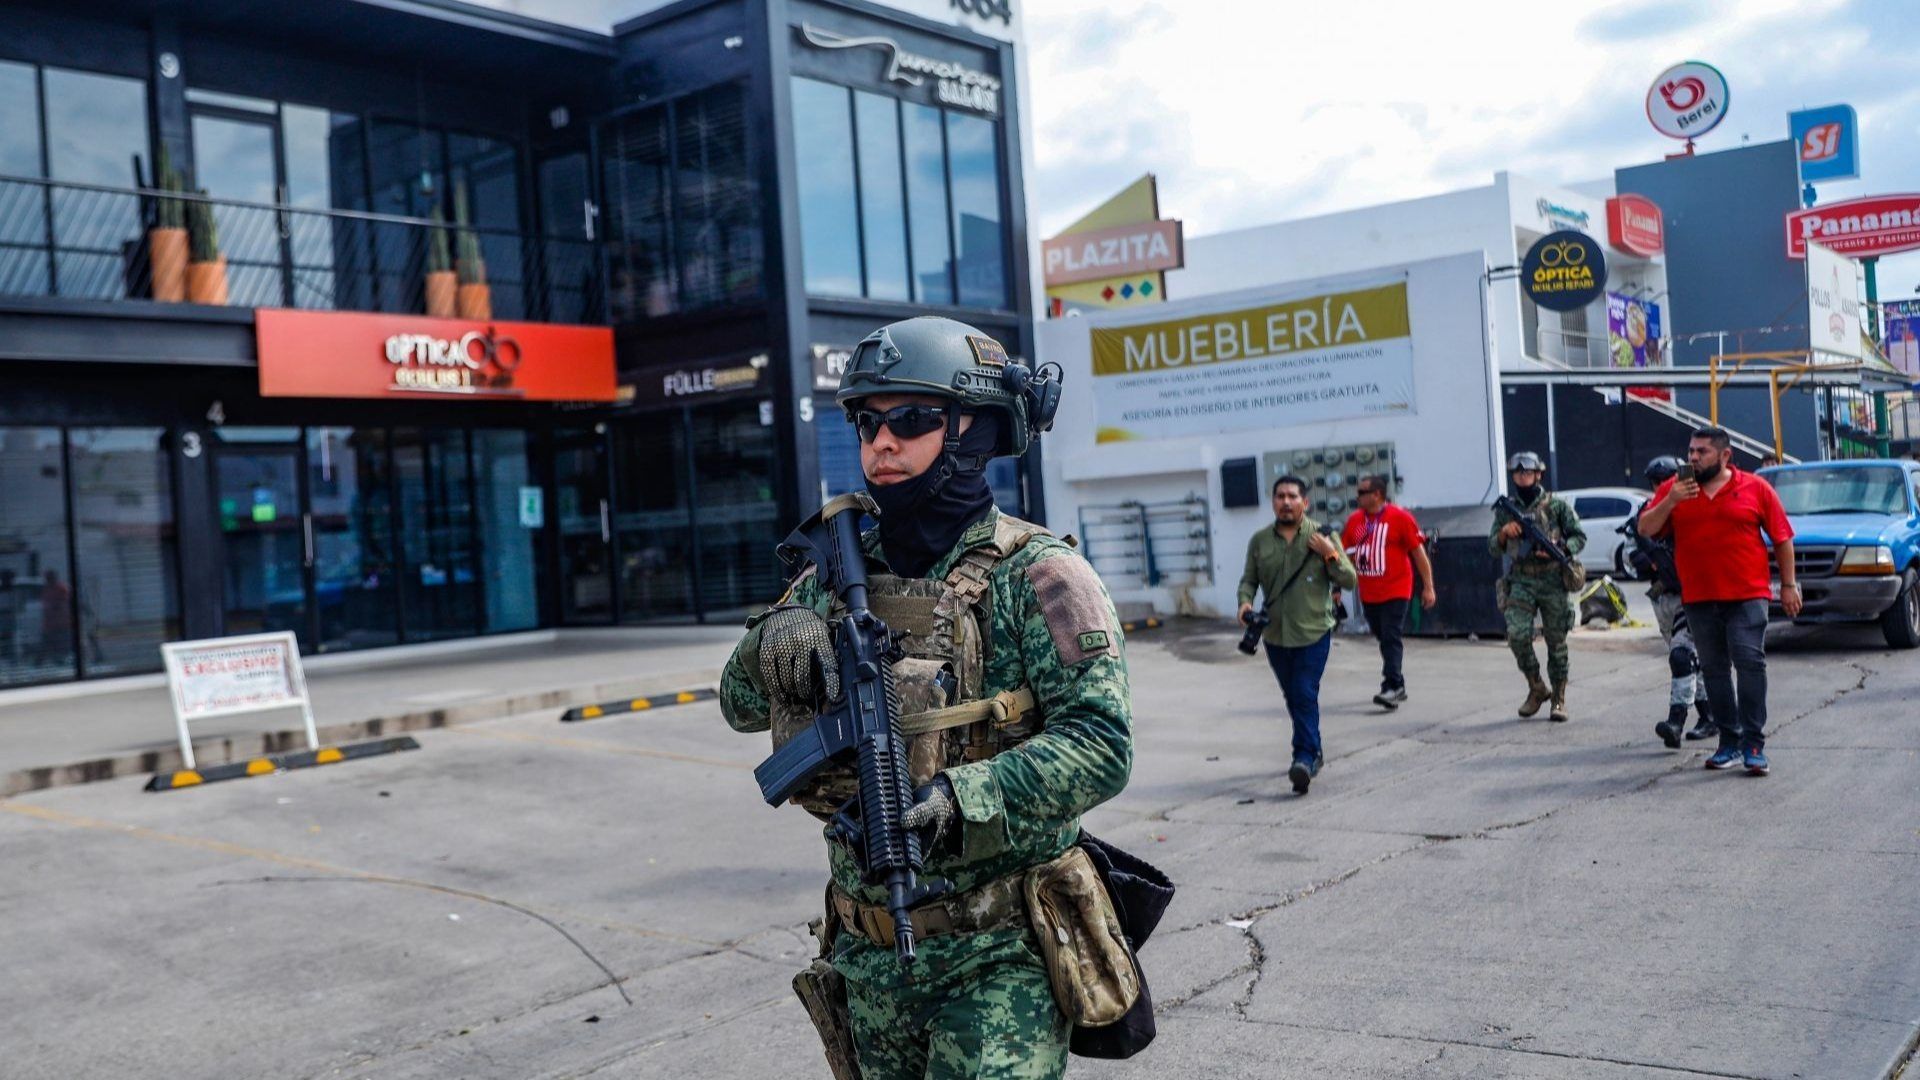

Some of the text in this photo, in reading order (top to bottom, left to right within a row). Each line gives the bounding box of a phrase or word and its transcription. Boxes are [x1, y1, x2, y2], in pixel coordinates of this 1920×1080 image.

[1676, 99, 1718, 130] Berel
[1045, 231, 1170, 275] PLAZITA
[1123, 297, 1368, 372] MUEBLERÍA
[799, 396, 814, 423] 5
[1251, 390, 1318, 408] INTERIORES
[1319, 382, 1380, 400] GRATUITA
[182, 431, 202, 459] 3
